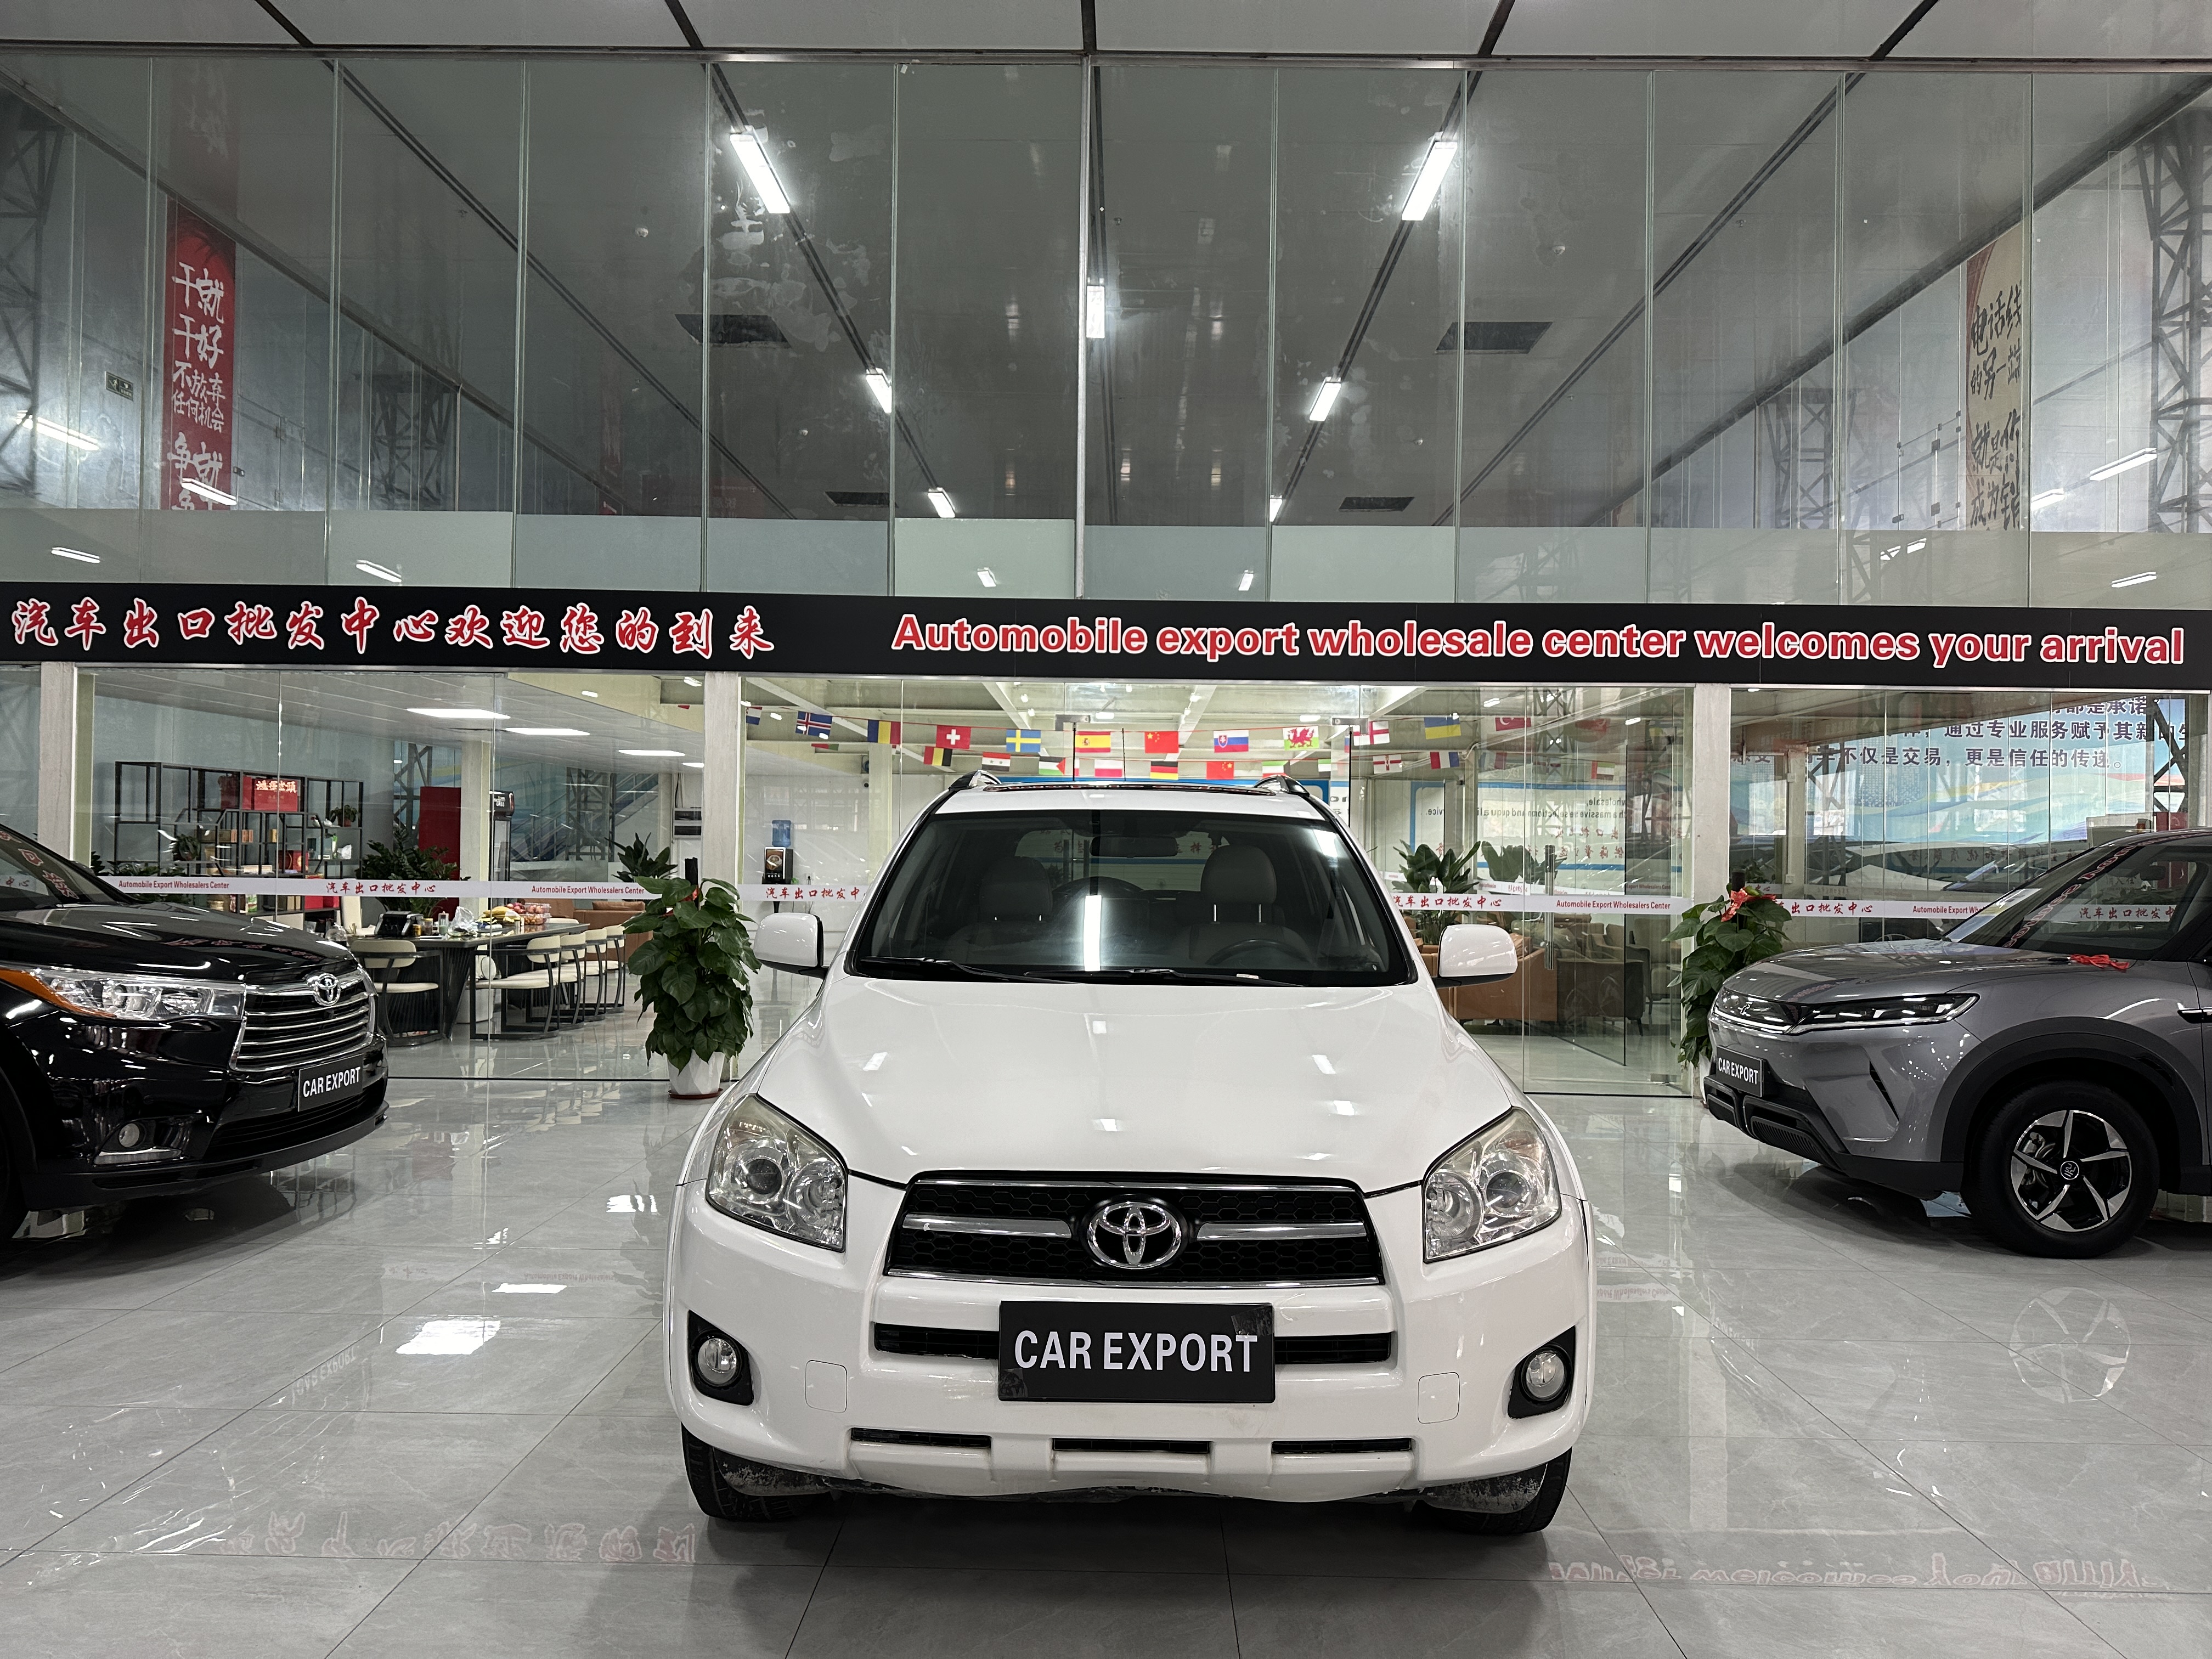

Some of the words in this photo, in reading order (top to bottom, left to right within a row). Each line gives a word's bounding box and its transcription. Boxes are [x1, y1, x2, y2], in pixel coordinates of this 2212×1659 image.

[172, 261, 224, 324] 干就
[173, 313, 223, 369] 干好
[173, 360, 225, 407] 不放弃
[172, 389, 224, 433] 任何机会
[11, 597, 775, 659] 汽车出口批发中心欢迎您的到来
[891, 613, 1148, 654] Automobile
[1156, 622, 1299, 662] export
[1307, 619, 1533, 657] wholesale
[1542, 624, 1686, 658] center
[1694, 622, 1920, 660] welcomes
[1928, 631, 2032, 669] your
[2040, 627, 2185, 664] arrival
[154, 881, 172, 889] Export
[326, 882, 436, 895] 汽车出口批发中心
[532, 885, 566, 893] Automobile
[567, 886, 586, 895] Export
[766, 887, 865, 900] 汽车出口批发中
[1556, 900, 1591, 908] Automobile
[1593, 900, 1612, 910] Export
[1613, 901, 1650, 909] Wholesalers
[1651, 901, 1671, 910] Center
[1913, 905, 1947, 913] Automobile
[1949, 906, 1968, 915] Export
[303, 1077, 324, 1098] CAR
[326, 1066, 361, 1092] EXPORT
[1718, 1057, 1730, 1075] CAR
[1731, 1062, 1758, 1085] EXPORT
[1014, 1330, 1091, 1369] CAR
[1104, 1331, 1258, 1372] EXPORT
